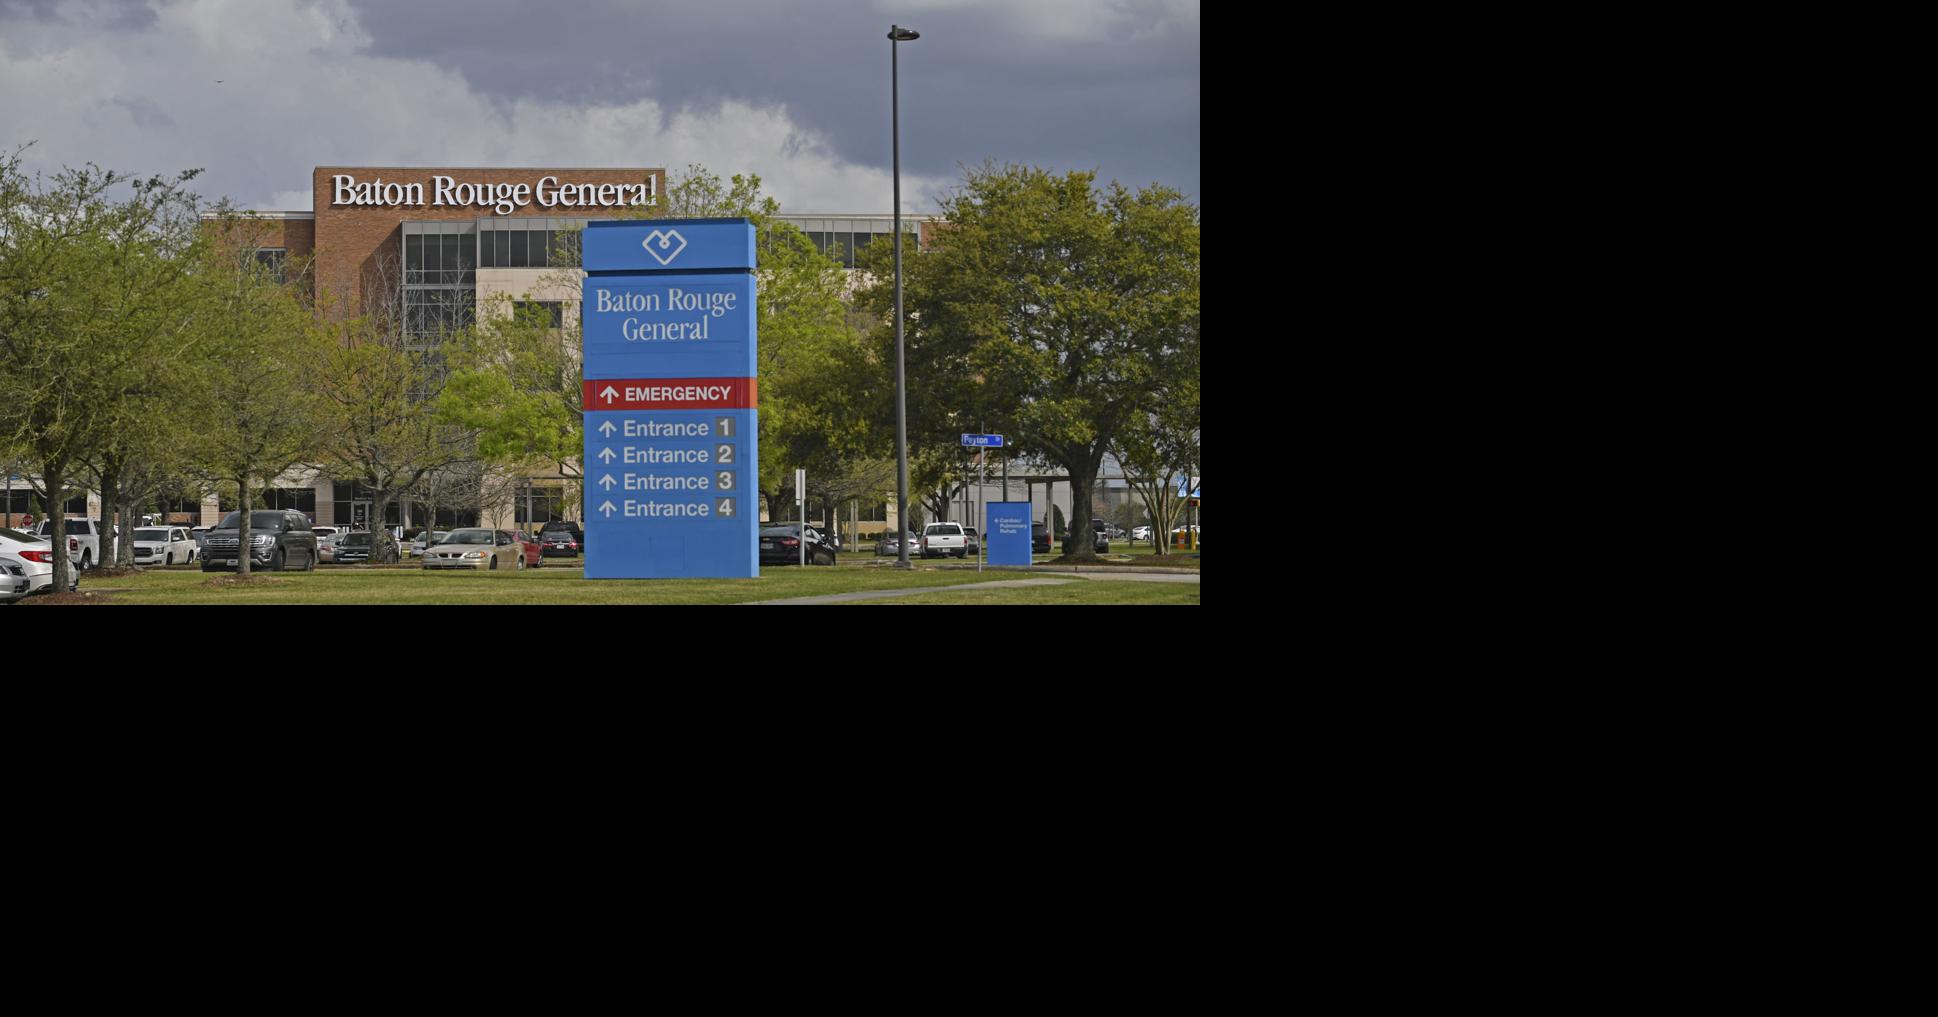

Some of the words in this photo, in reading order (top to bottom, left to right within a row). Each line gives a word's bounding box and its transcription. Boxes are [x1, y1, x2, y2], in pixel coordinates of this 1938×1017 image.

[331, 174, 426, 206] Baton
[432, 175, 531, 215] Rouge
[535, 174, 657, 207] General
[596, 288, 660, 313] Baton
[667, 287, 737, 318] Rouge
[623, 315, 709, 341] General
[625, 385, 731, 401] EMERGENCY
[623, 418, 710, 437] Entrance
[719, 418, 730, 436] 1
[623, 445, 710, 464] Entrance
[718, 445, 732, 463] 2
[623, 472, 710, 491] Entrance
[718, 471, 733, 490] 3
[623, 498, 710, 517] Entrance
[718, 498, 733, 517] 4
